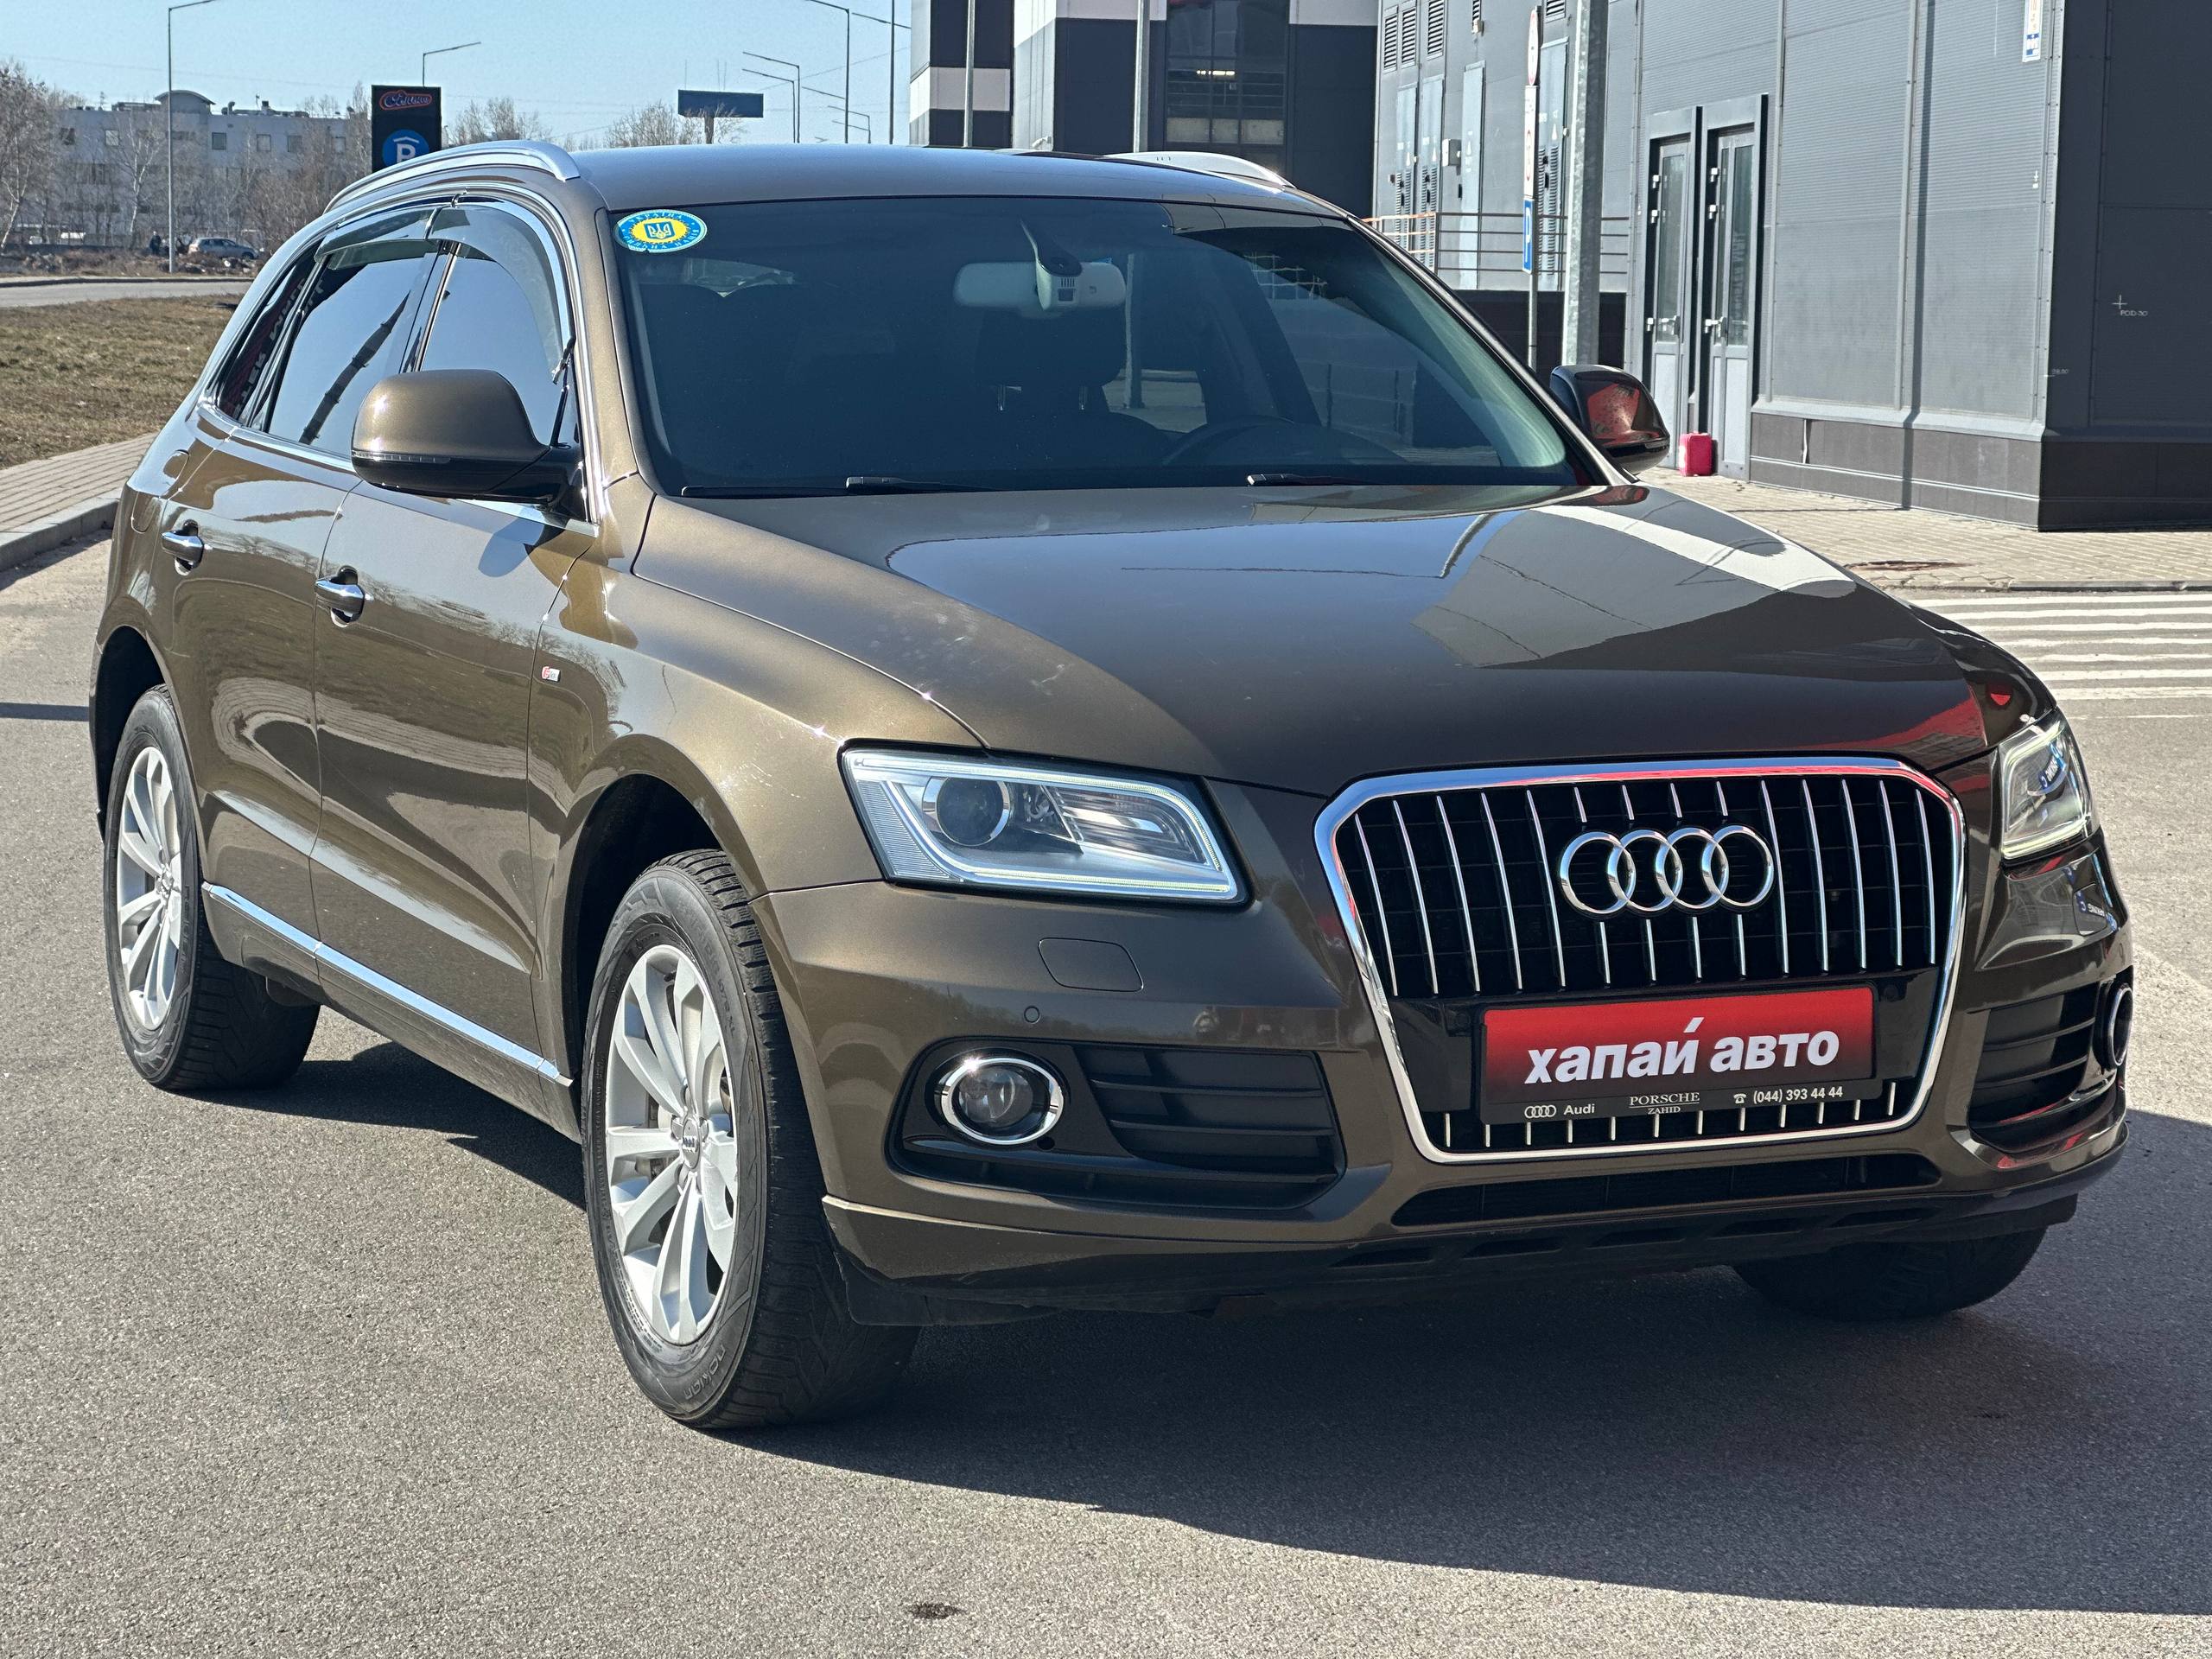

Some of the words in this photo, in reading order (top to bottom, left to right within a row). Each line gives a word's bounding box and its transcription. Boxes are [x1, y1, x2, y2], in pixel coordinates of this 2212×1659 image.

[397, 143, 416, 163] P
[1711, 1031, 1839, 1072] авто
[1630, 1092, 1700, 1106] PORSCHE
[1753, 1089, 1783, 1104] (044)
[1786, 1088, 1808, 1101] 393
[1810, 1087, 1825, 1099] 44
[1828, 1086, 1843, 1098] 44
[1564, 1103, 1595, 1115] Audi
[1647, 1105, 1681, 1115] ZAHID
